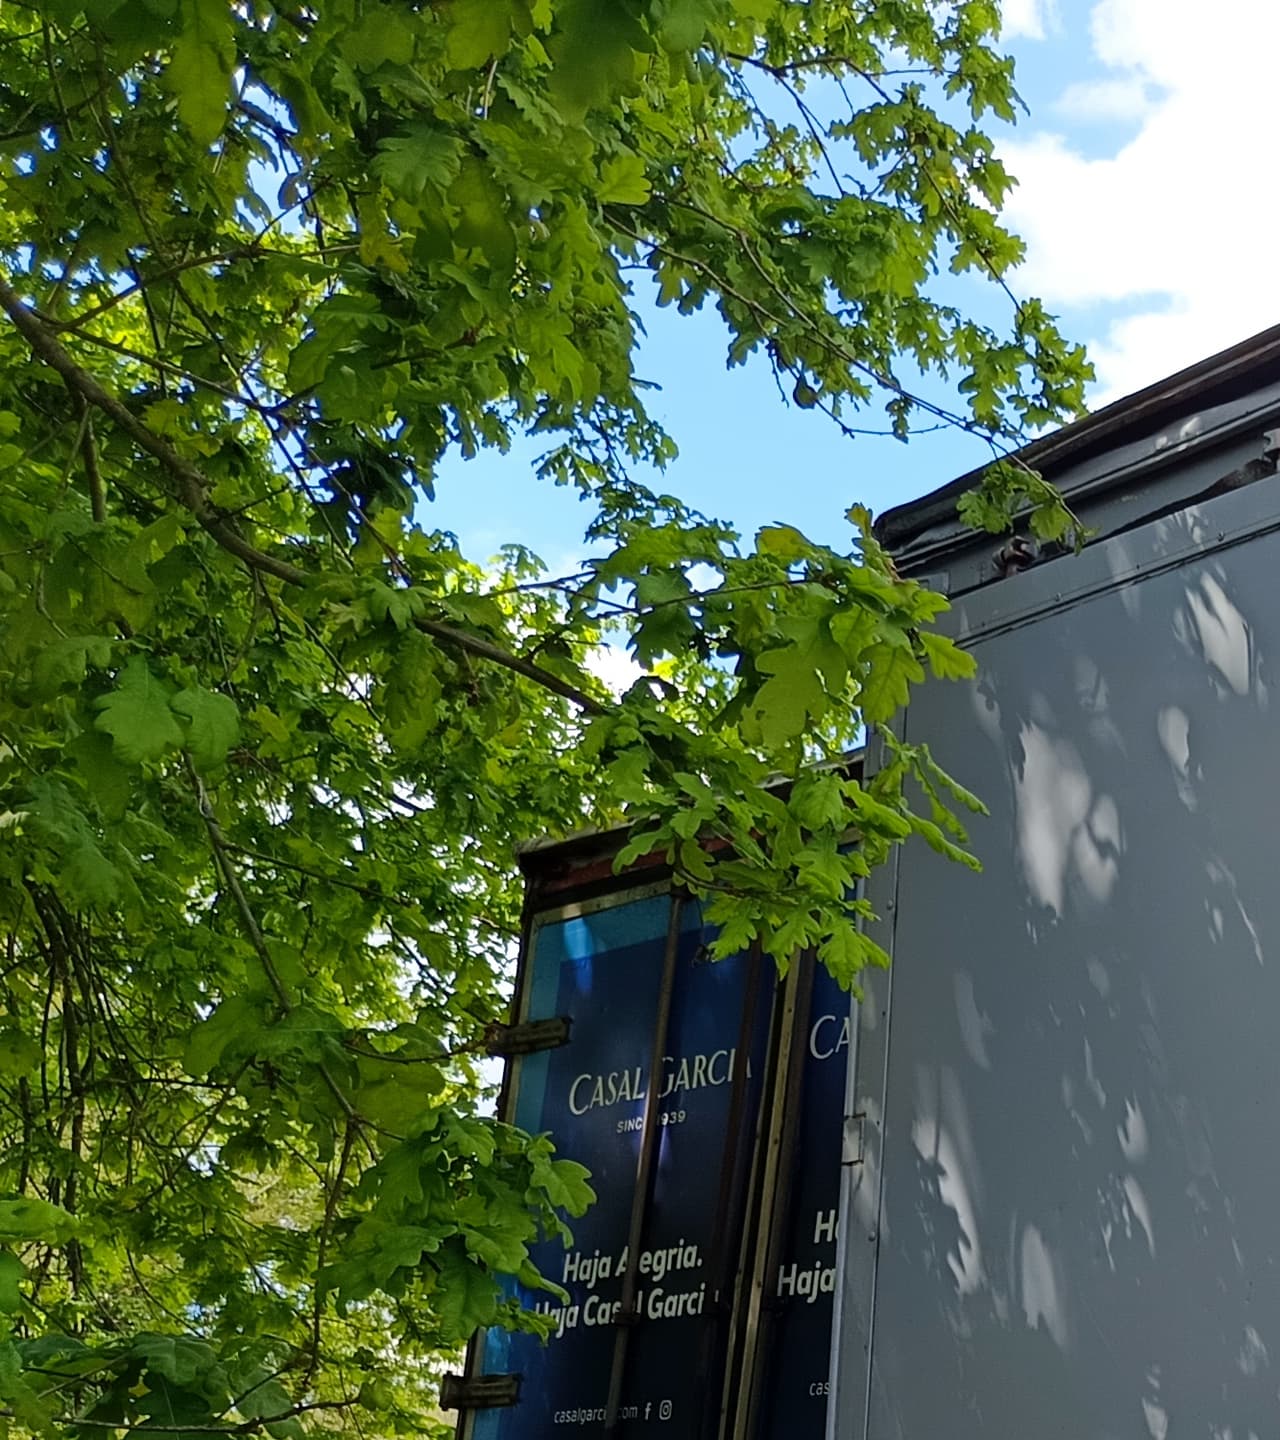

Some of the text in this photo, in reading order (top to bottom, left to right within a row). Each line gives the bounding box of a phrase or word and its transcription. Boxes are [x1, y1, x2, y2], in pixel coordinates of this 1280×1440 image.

[568, 1048, 752, 1116] CASAL GARCI
[616, 1116, 643, 1134] SINC
[562, 1238, 702, 1289] Haja Aegria.
[584, 1294, 643, 1326] Casl
[648, 1282, 720, 1320] Garci
